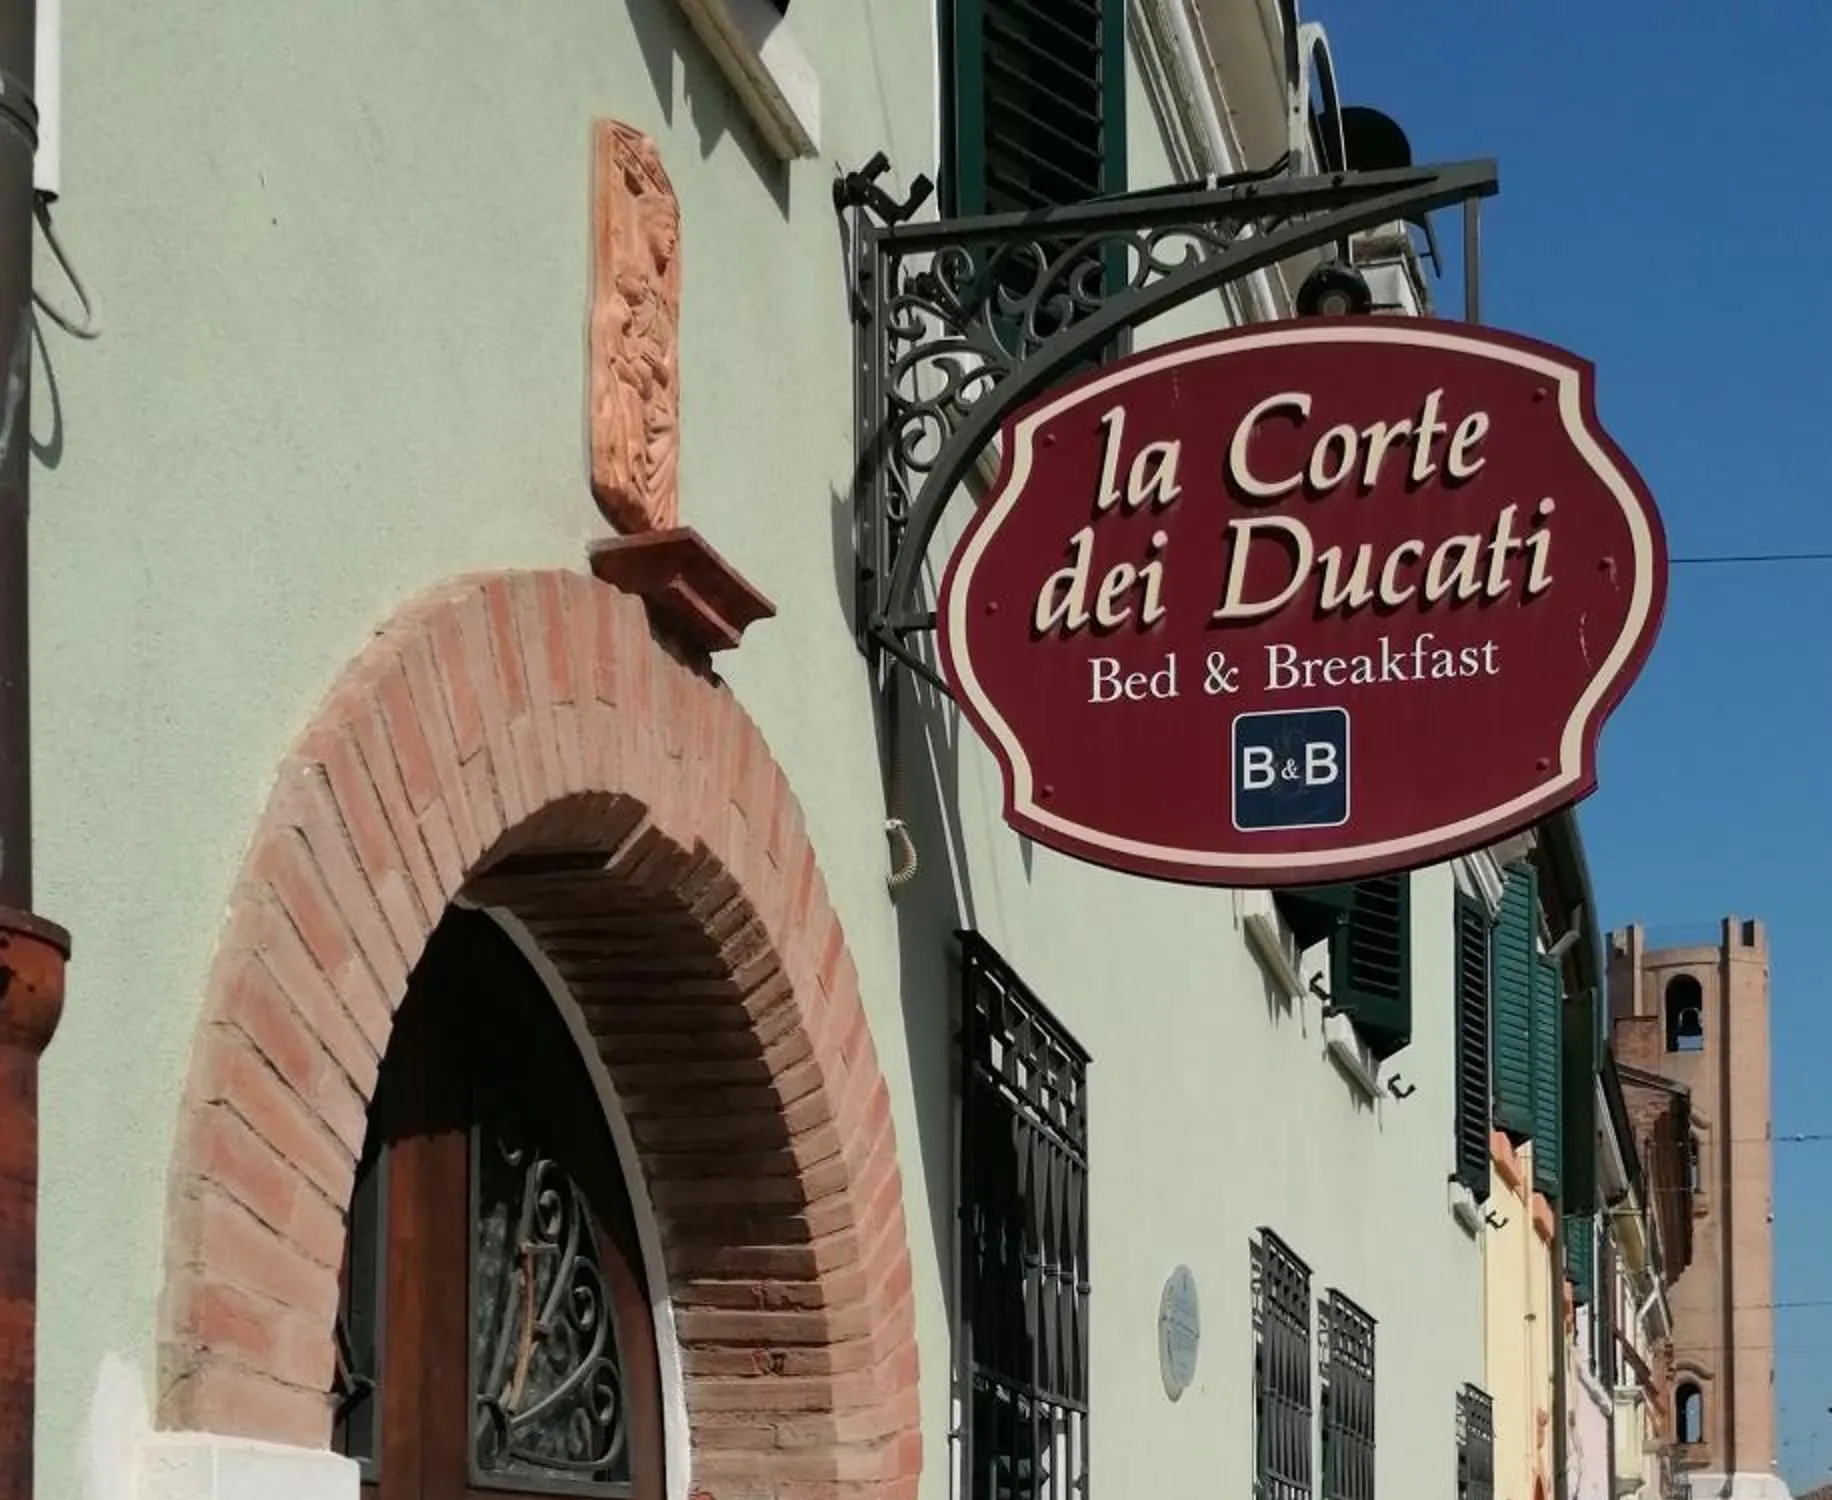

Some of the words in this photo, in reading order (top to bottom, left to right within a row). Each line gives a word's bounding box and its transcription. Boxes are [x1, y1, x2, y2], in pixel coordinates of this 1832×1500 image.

[1097, 405, 1182, 509] la
[1229, 388, 1490, 496] Corte
[1035, 526, 1169, 632] dei
[1213, 496, 1556, 619] Ducati
[1087, 652, 1180, 703] Bed
[1203, 651, 1239, 695] &
[1263, 632, 1500, 691] Breakfast
[1243, 741, 1339, 790] B&B
